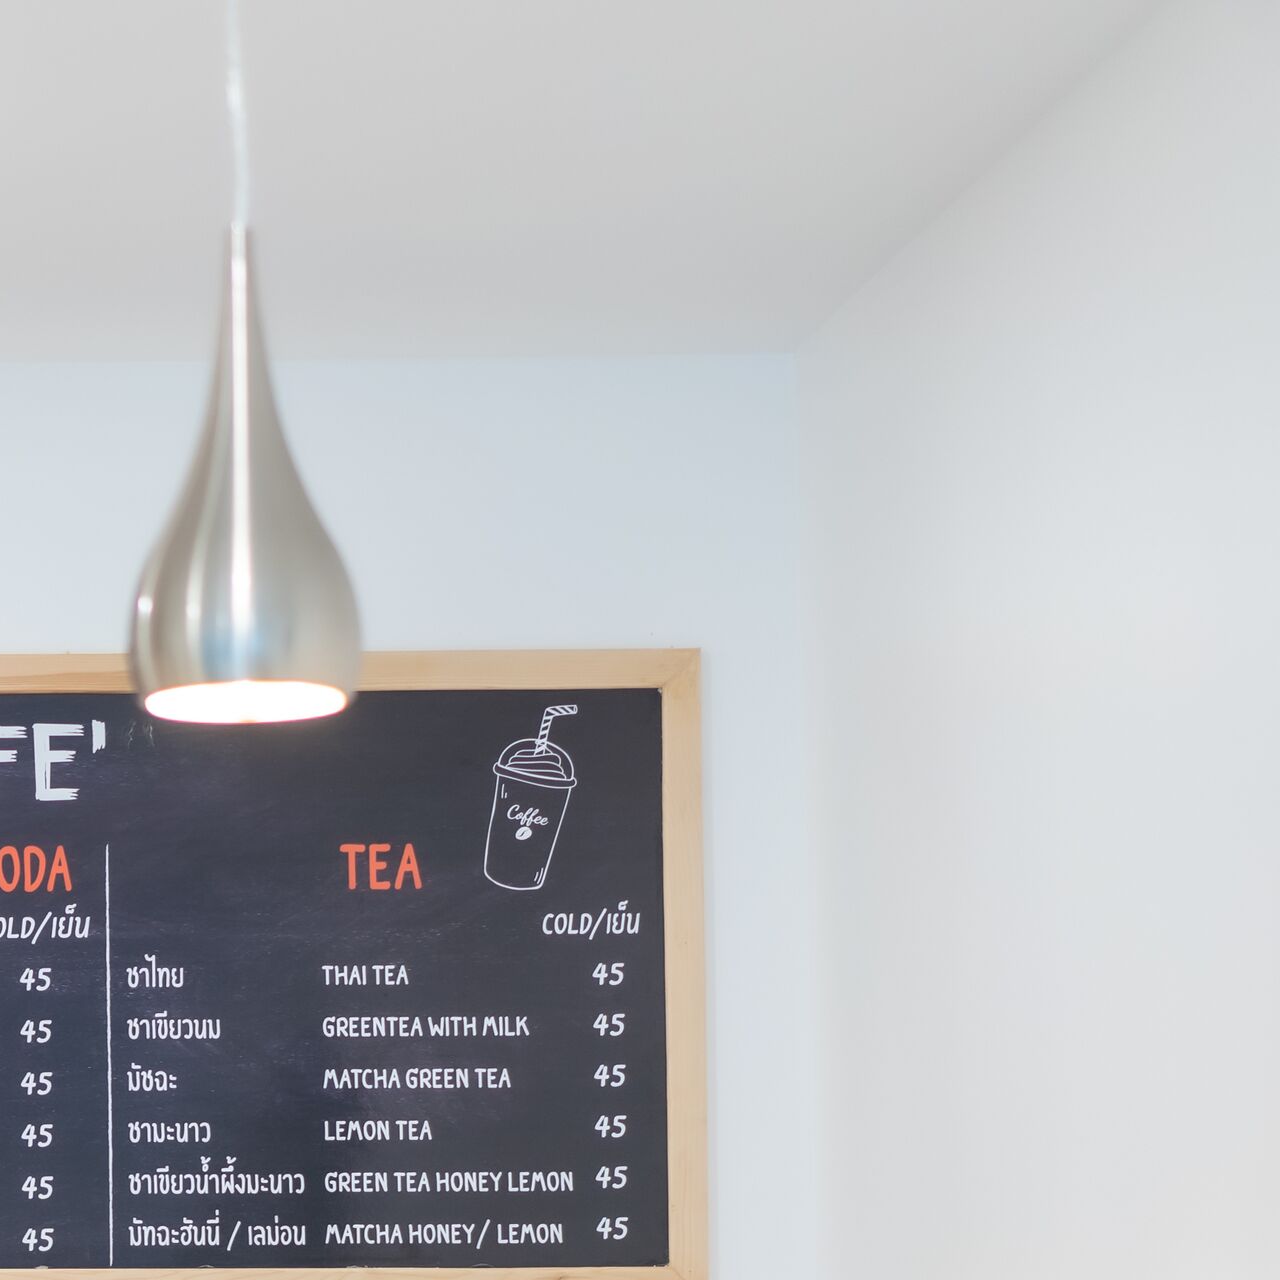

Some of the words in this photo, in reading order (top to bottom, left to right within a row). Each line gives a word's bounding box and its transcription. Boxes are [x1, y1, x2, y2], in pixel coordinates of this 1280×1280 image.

[506, 804, 549, 827] Coffee
[339, 843, 422, 890] TEA
[19, 967, 52, 992] 45
[126, 953, 184, 989] ชาไทย
[321, 965, 367, 986] THAI
[371, 964, 409, 986] TEA
[592, 962, 625, 986] 45
[19, 1019, 53, 1044] 45
[126, 1010, 221, 1040] ชาเขียวนม
[322, 1016, 424, 1038] GREENTEA
[427, 1016, 477, 1037] WITH
[482, 1015, 530, 1037] MILK
[592, 1013, 626, 1037] 45
[20, 1071, 53, 1096] 45
[126, 1062, 177, 1092] มัชฉะ
[323, 1068, 401, 1090] MATCHA
[405, 1067, 469, 1089] GREEN
[474, 1067, 512, 1089] TEA
[593, 1064, 626, 1088] 45
[20, 1123, 54, 1148] 45
[127, 1121, 211, 1144] ชามะนาว
[324, 1120, 390, 1141] LEMON
[395, 1119, 433, 1141] TEA
[594, 1114, 627, 1138] 45
[21, 1175, 54, 1200] 45
[324, 1171, 388, 1193] GREEN
[393, 1171, 431, 1193] TEA
[435, 1171, 503, 1193] HONEY
[507, 1171, 574, 1192] LEMON
[595, 1165, 628, 1189] 45
[21, 1227, 55, 1252] 45
[325, 1223, 403, 1245] MATCHA
[497, 1223, 563, 1244] LEMON
[596, 1216, 629, 1240] 45
